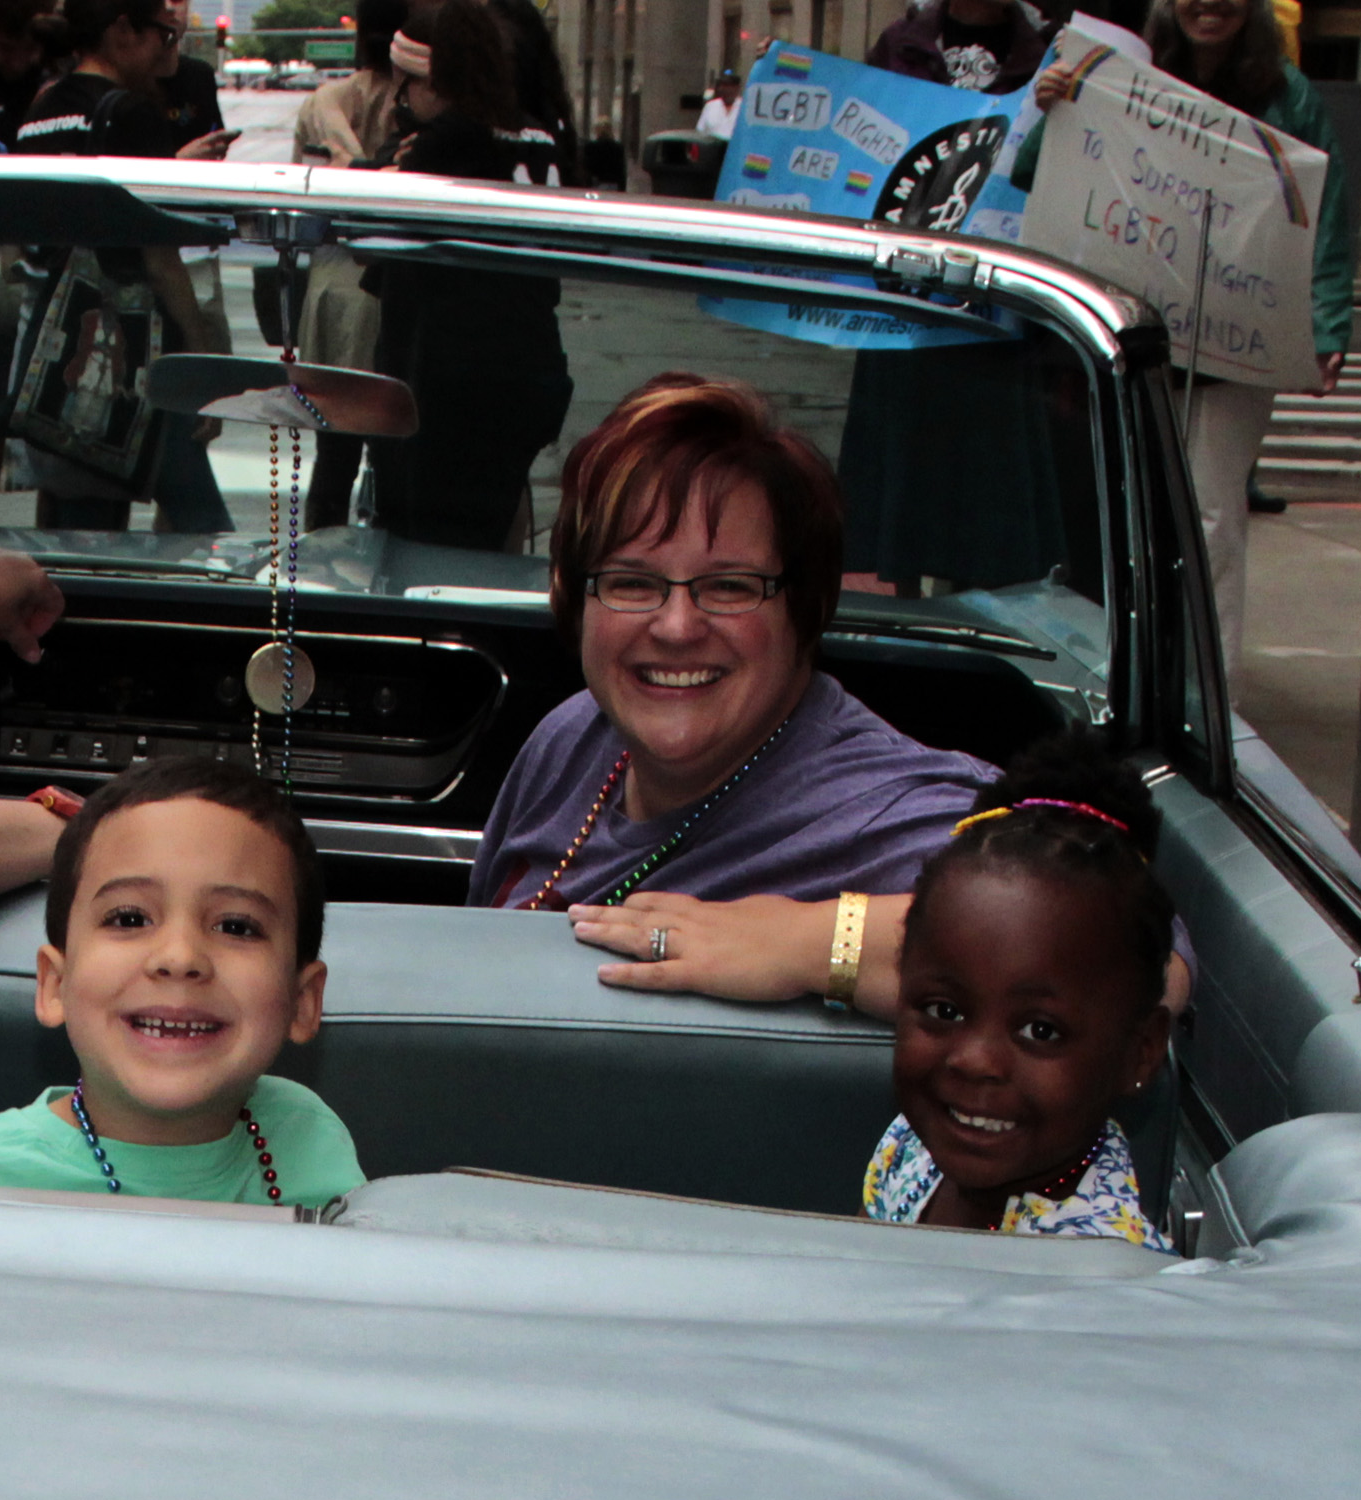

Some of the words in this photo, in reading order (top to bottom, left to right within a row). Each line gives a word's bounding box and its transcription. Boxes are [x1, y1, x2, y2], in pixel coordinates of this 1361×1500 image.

[754, 87, 828, 125] LGBT
[836, 102, 902, 164] RIGHTS
[1126, 72, 1237, 164] HONK!
[792, 150, 836, 179] ARE
[1084, 190, 1178, 265] LGBTQ
